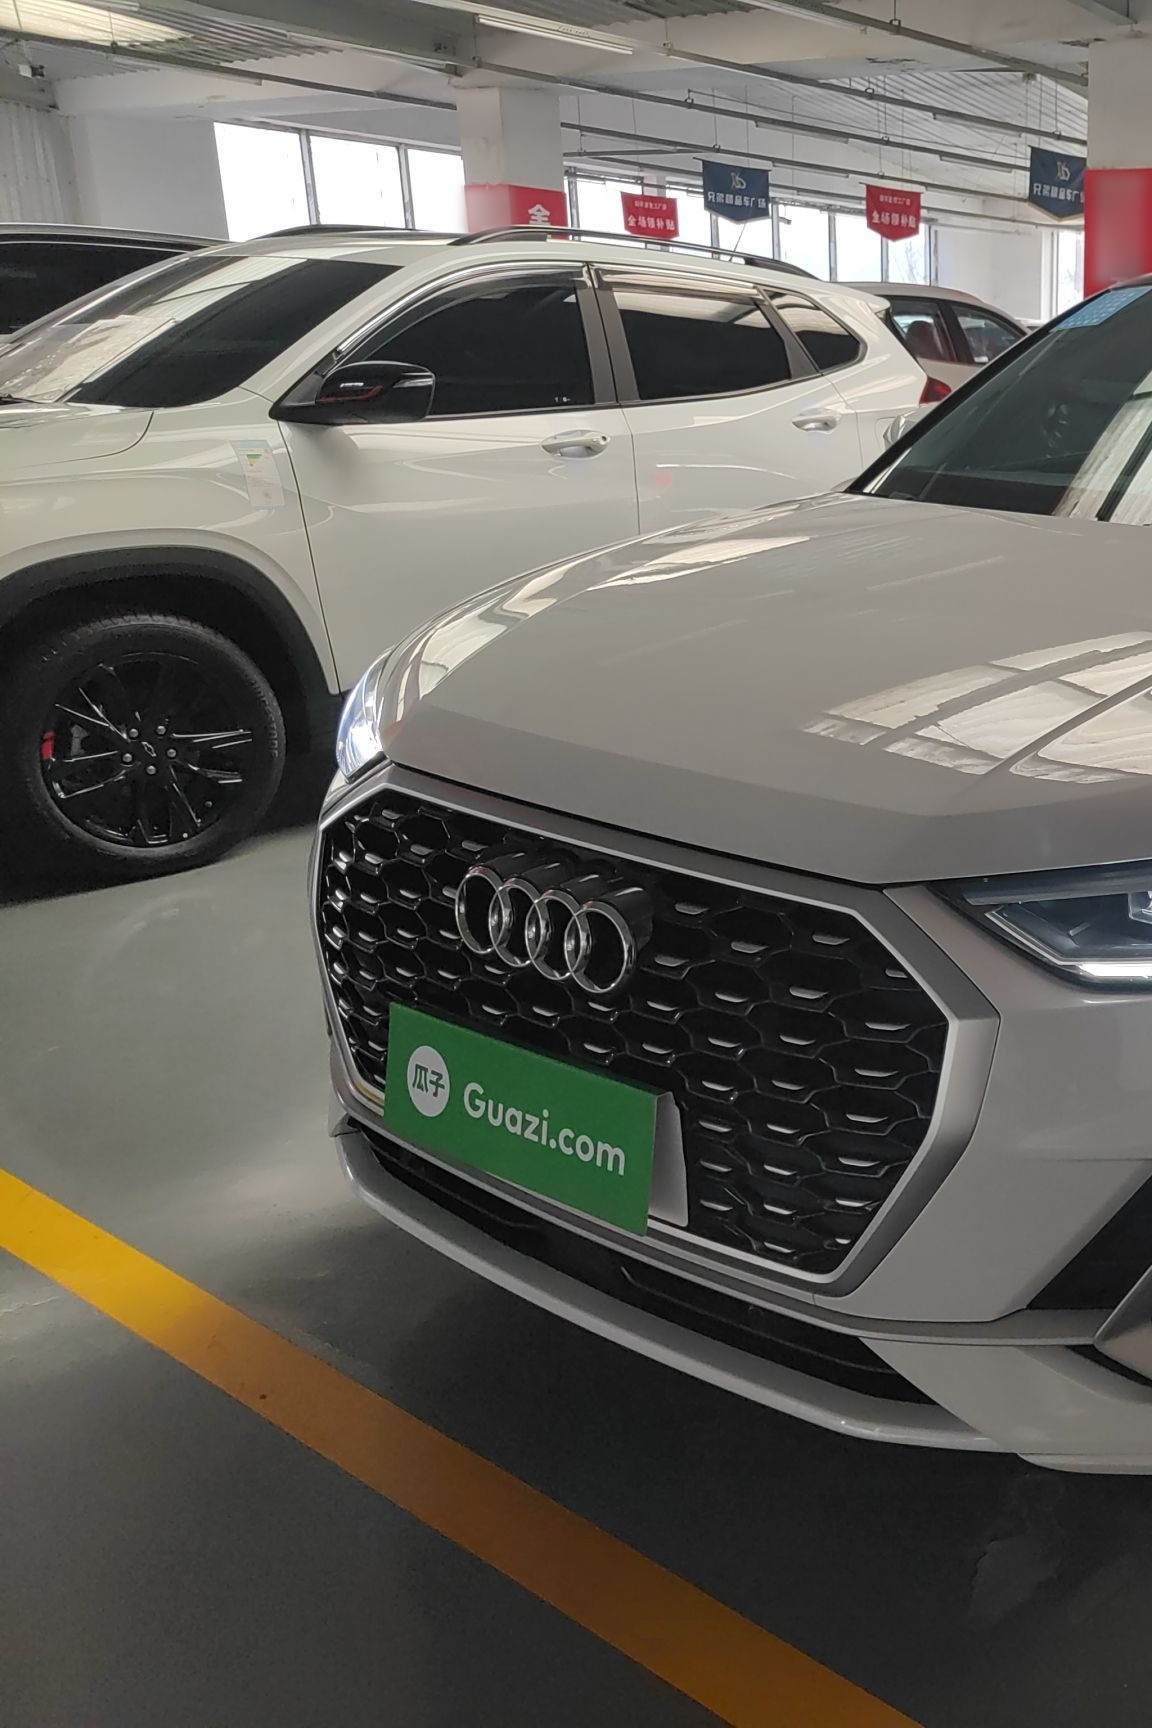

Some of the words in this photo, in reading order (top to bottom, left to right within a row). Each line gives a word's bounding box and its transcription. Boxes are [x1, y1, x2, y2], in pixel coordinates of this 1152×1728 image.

[527, 203, 551, 225] 全
[411, 1063, 446, 1098] 瓜子
[463, 1081, 627, 1177] Guazi.com
